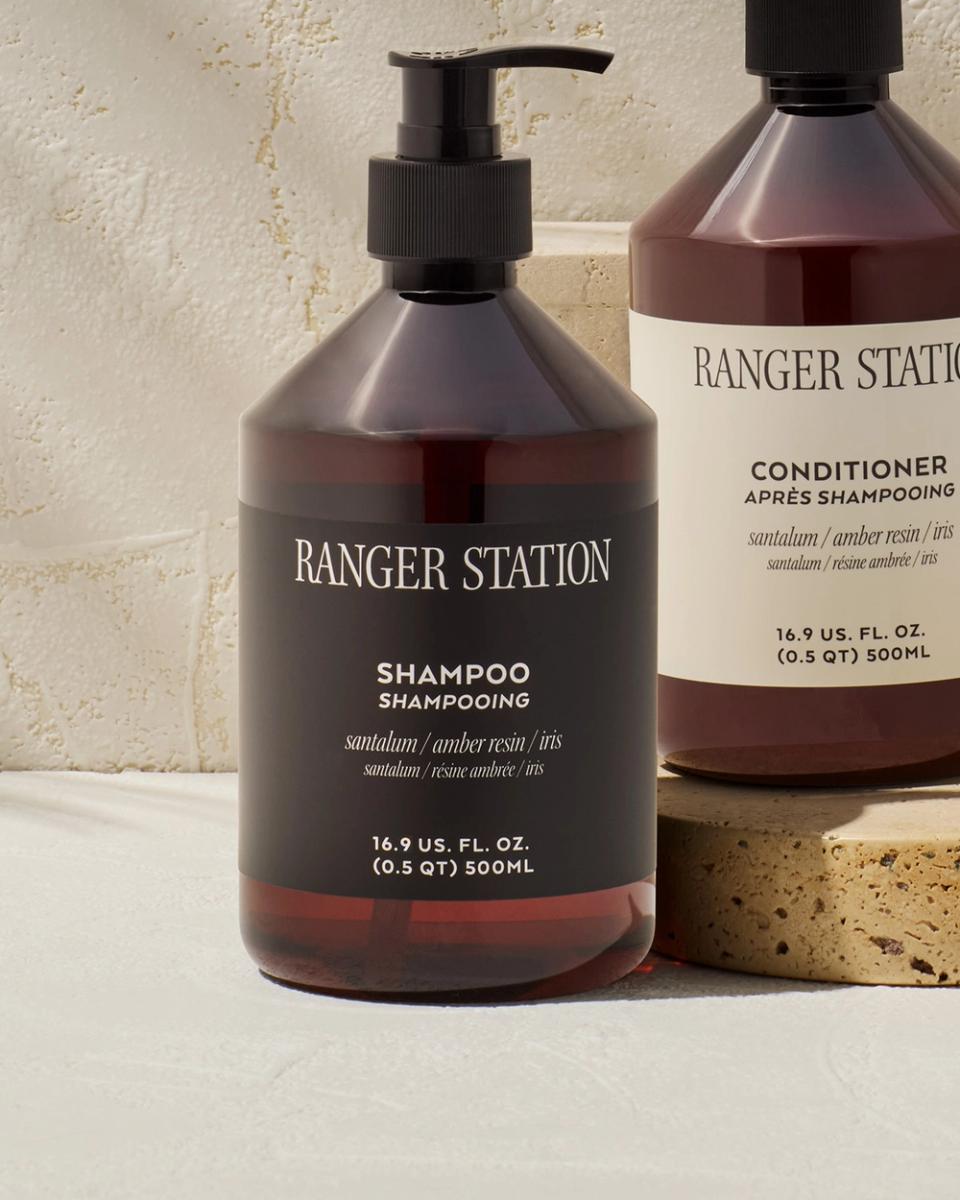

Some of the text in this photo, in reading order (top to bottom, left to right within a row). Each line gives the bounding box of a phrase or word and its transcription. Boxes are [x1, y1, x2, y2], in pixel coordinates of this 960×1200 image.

[693, 346, 845, 391] RANGER
[751, 455, 949, 483] CONDITIONER
[743, 482, 955, 506] APRÈS SHAMPOOING
[747, 525, 819, 547] santalum
[832, 524, 884, 547] amber
[885, 523, 921, 545] resin
[932, 520, 955, 541] iris
[295, 538, 612, 591] RANGER STATION
[766, 554, 822, 571] santalum
[831, 553, 867, 571] résine
[868, 551, 912, 569] ambrée
[920, 549, 939, 566] iris
[776, 623, 926, 642] 16.9 US. FL. OZ.
[777, 644, 931, 665] (0.5 QT) 500ML
[377, 662, 530, 685] SHAMPOO
[378, 692, 530, 710] SHAMPOOING
[344, 730, 418, 753] santalum
[432, 731, 487, 754] amber
[487, 730, 526, 753] resin
[539, 729, 563, 751] iris
[363, 759, 421, 778] santalum
[431, 762, 469, 779] résine
[469, 760, 516, 778] ambrée
[525, 759, 545, 776] iris
[372, 836, 529, 853] 16.9 US. FL. OZ.
[372, 856, 535, 878] (0.5 QT) 500ML
